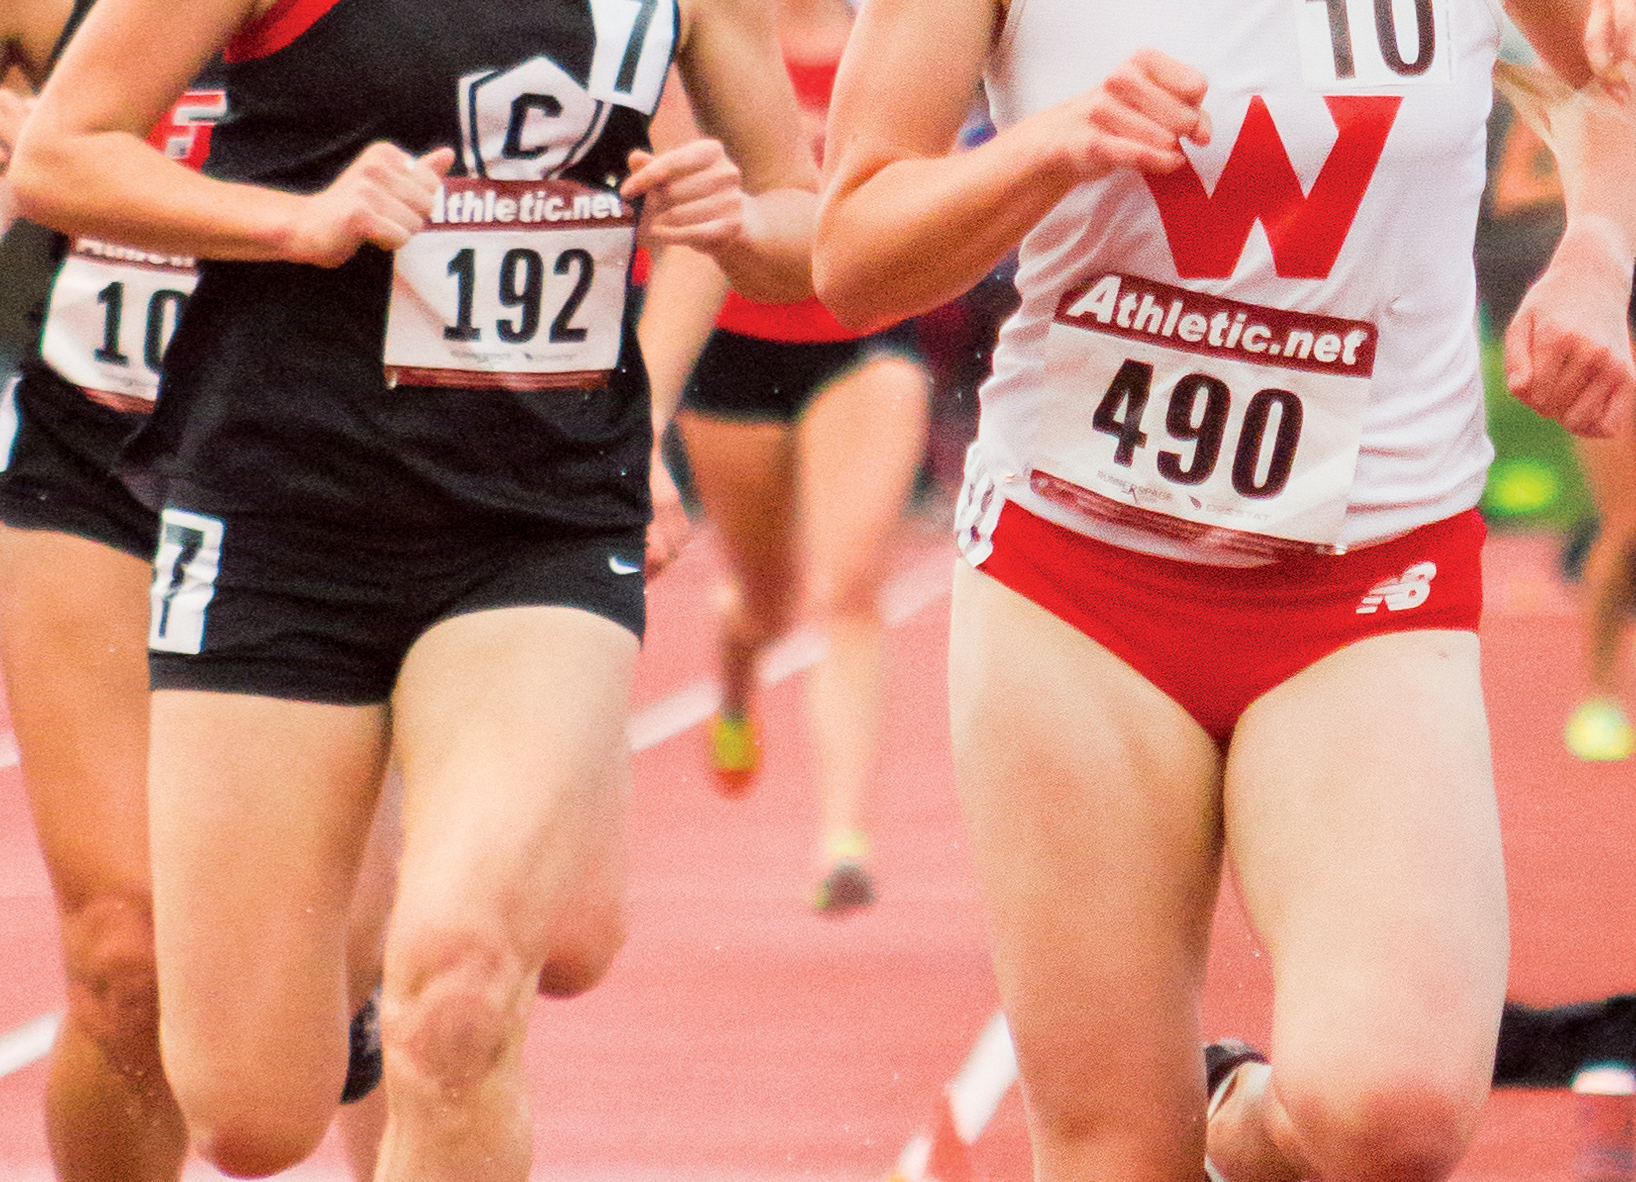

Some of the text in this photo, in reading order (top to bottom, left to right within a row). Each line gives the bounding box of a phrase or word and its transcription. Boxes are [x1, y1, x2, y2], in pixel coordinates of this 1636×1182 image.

[502, 92, 563, 159] C
[1145, 95, 1404, 279] W
[443, 248, 594, 343] 192
[1065, 275, 1367, 365] Athletic.net
[1092, 358, 1304, 500] 490
[158, 522, 205, 638] 7
